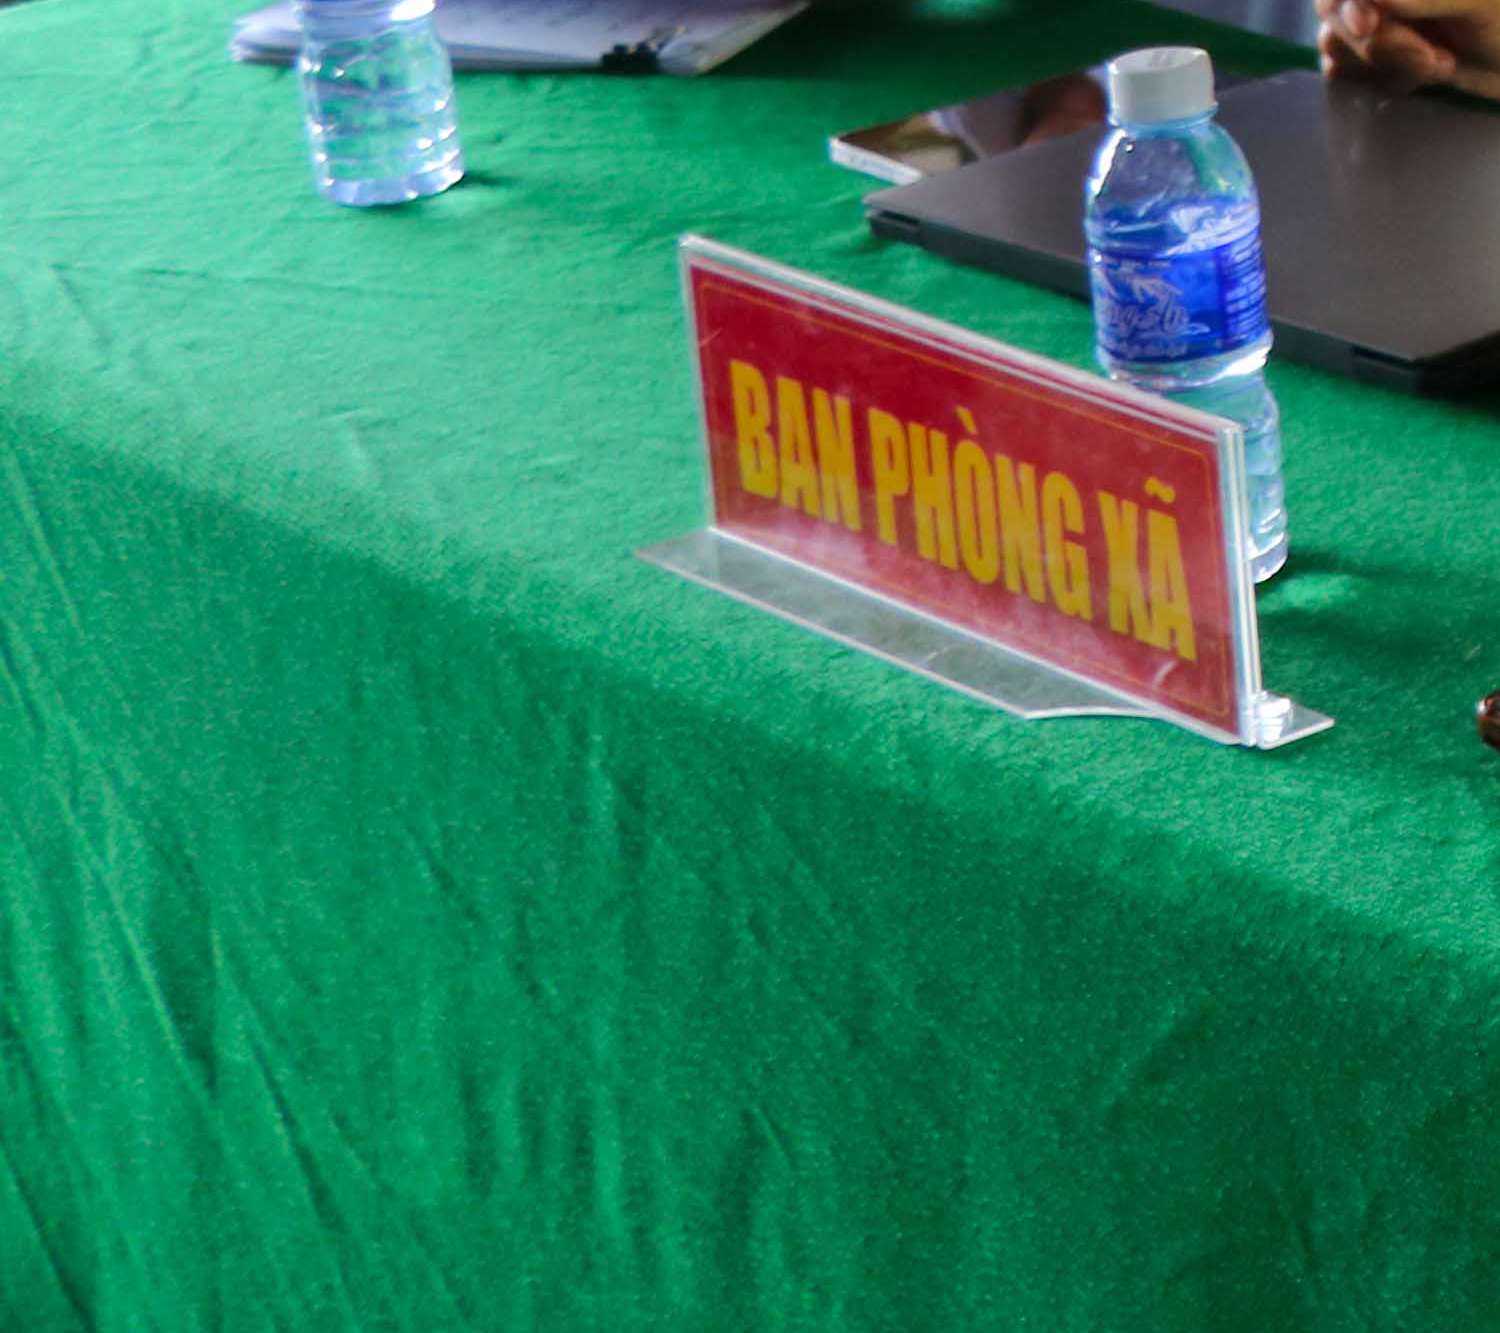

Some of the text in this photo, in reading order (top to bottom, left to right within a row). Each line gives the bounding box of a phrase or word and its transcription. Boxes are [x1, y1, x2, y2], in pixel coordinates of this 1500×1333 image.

[730, 359, 1198, 662] BAN PHÒNG XÃ
